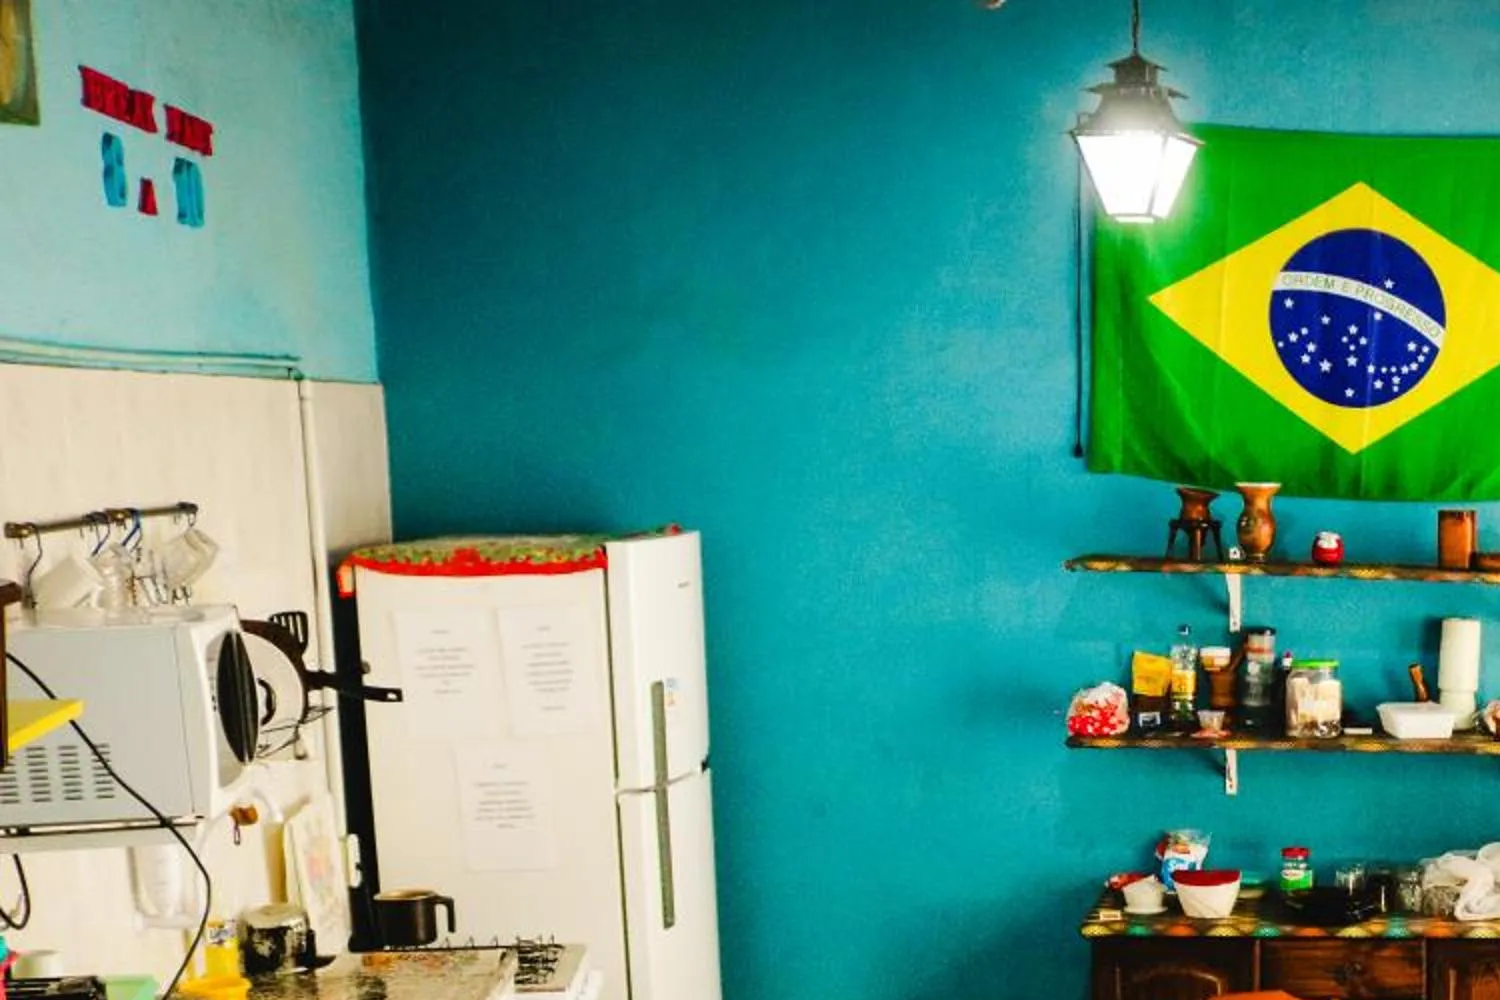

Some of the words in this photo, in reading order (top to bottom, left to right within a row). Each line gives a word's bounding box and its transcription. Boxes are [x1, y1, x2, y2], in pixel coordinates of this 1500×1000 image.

[1282, 273, 1335, 290] ORDEM
[1340, 279, 1351, 294] E
[1355, 285, 1441, 338] PROGRESSO
